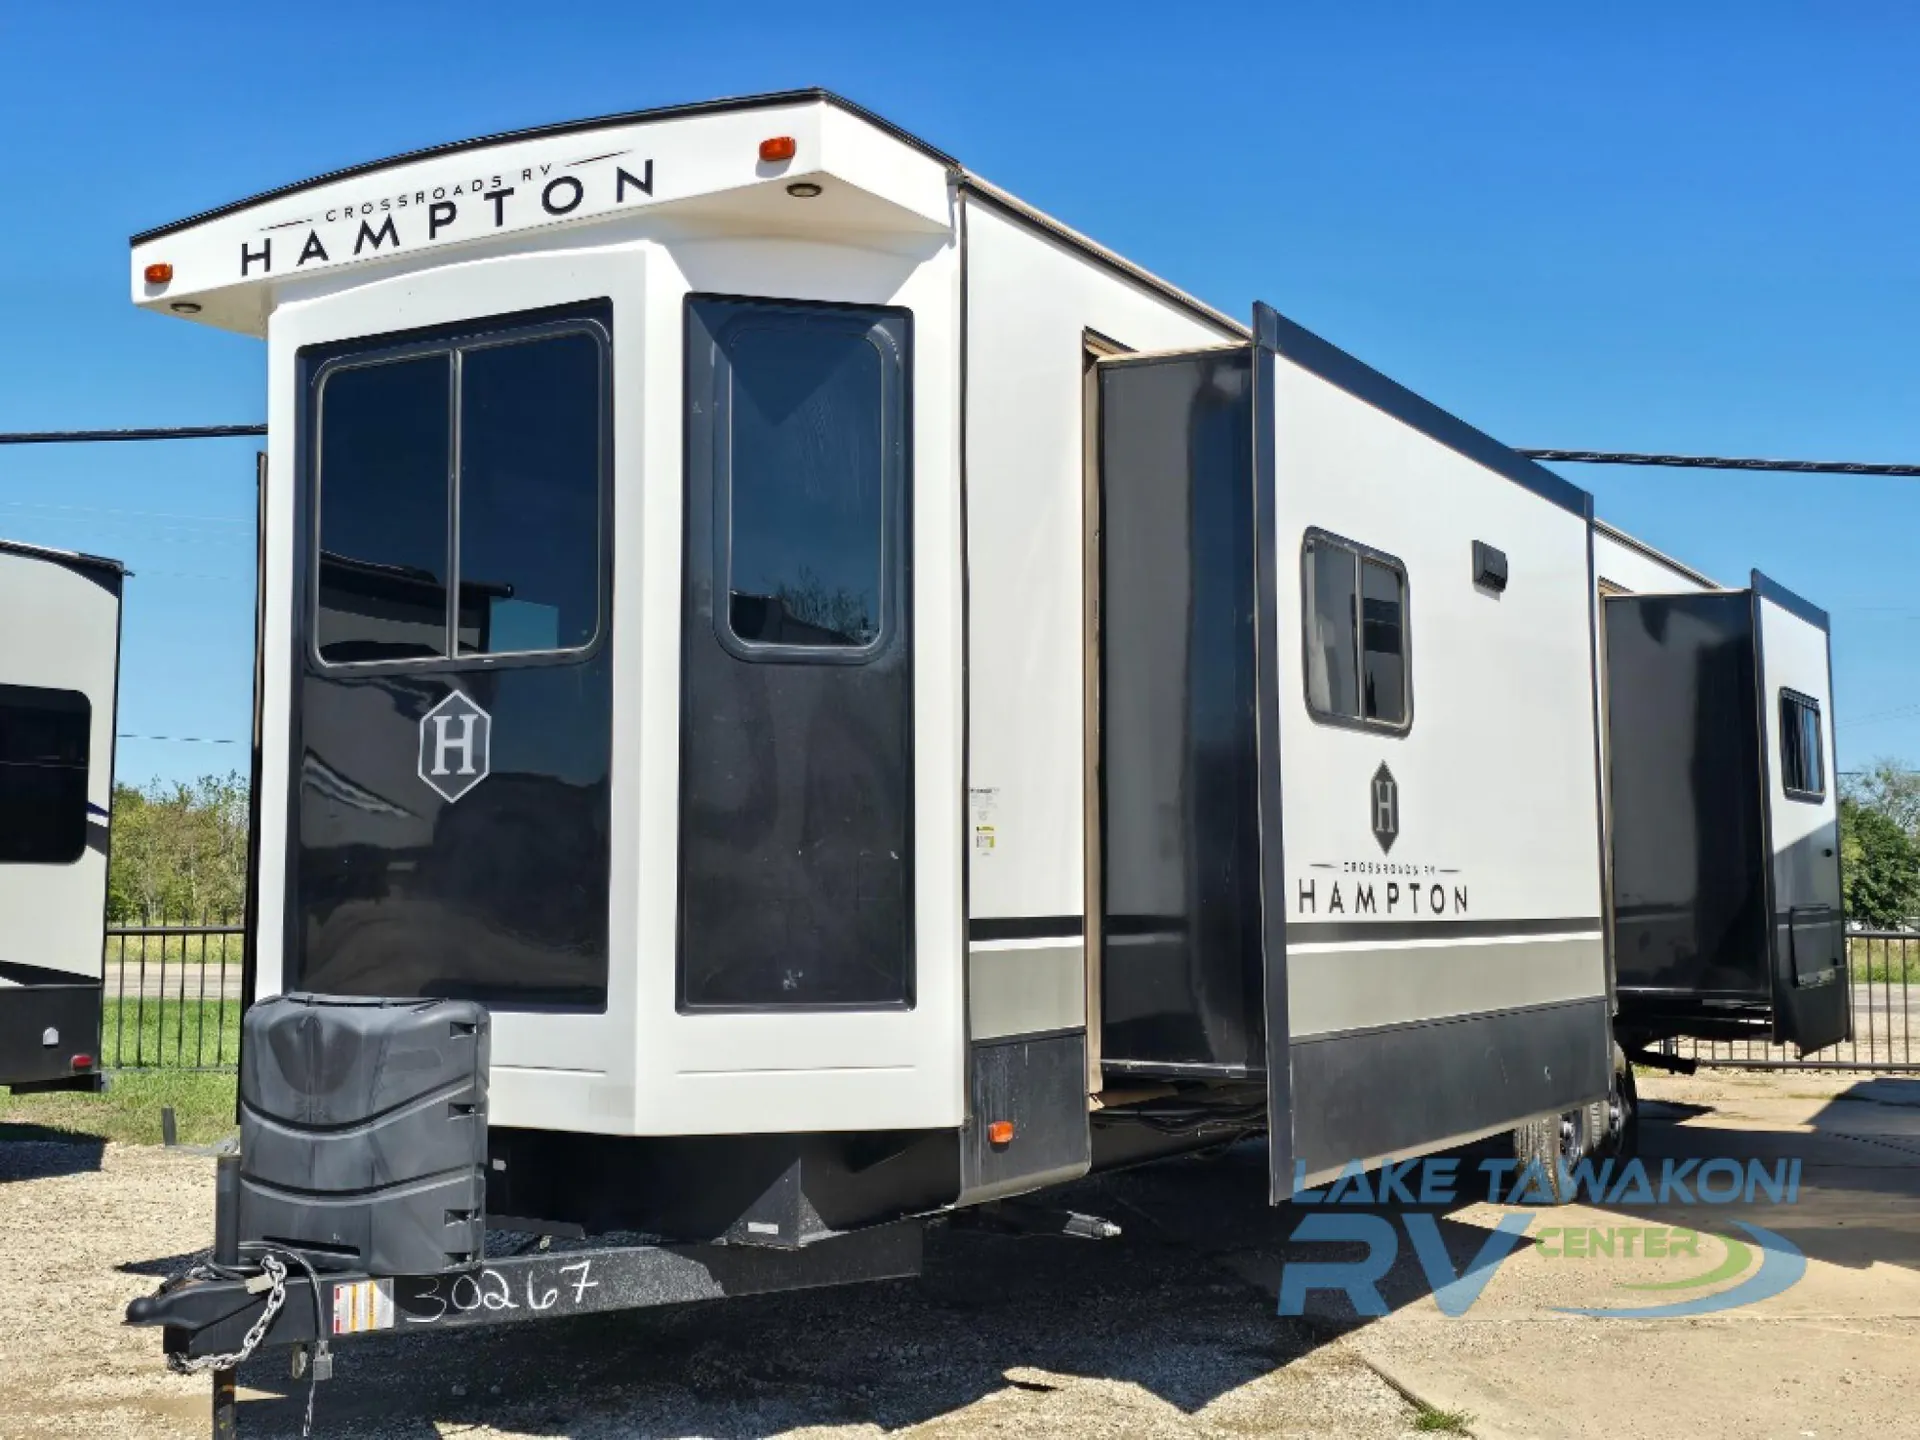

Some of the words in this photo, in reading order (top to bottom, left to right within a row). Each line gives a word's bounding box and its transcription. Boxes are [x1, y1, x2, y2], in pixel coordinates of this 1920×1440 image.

[241, 159, 654, 277] HAMPTON
[325, 175, 502, 222] CROSSROADS
[521, 163, 552, 181] RV
[431, 714, 479, 775] H
[1375, 779, 1396, 833] H
[1298, 878, 1468, 915] HAMPTON
[405, 1259, 599, 1322] 30267
